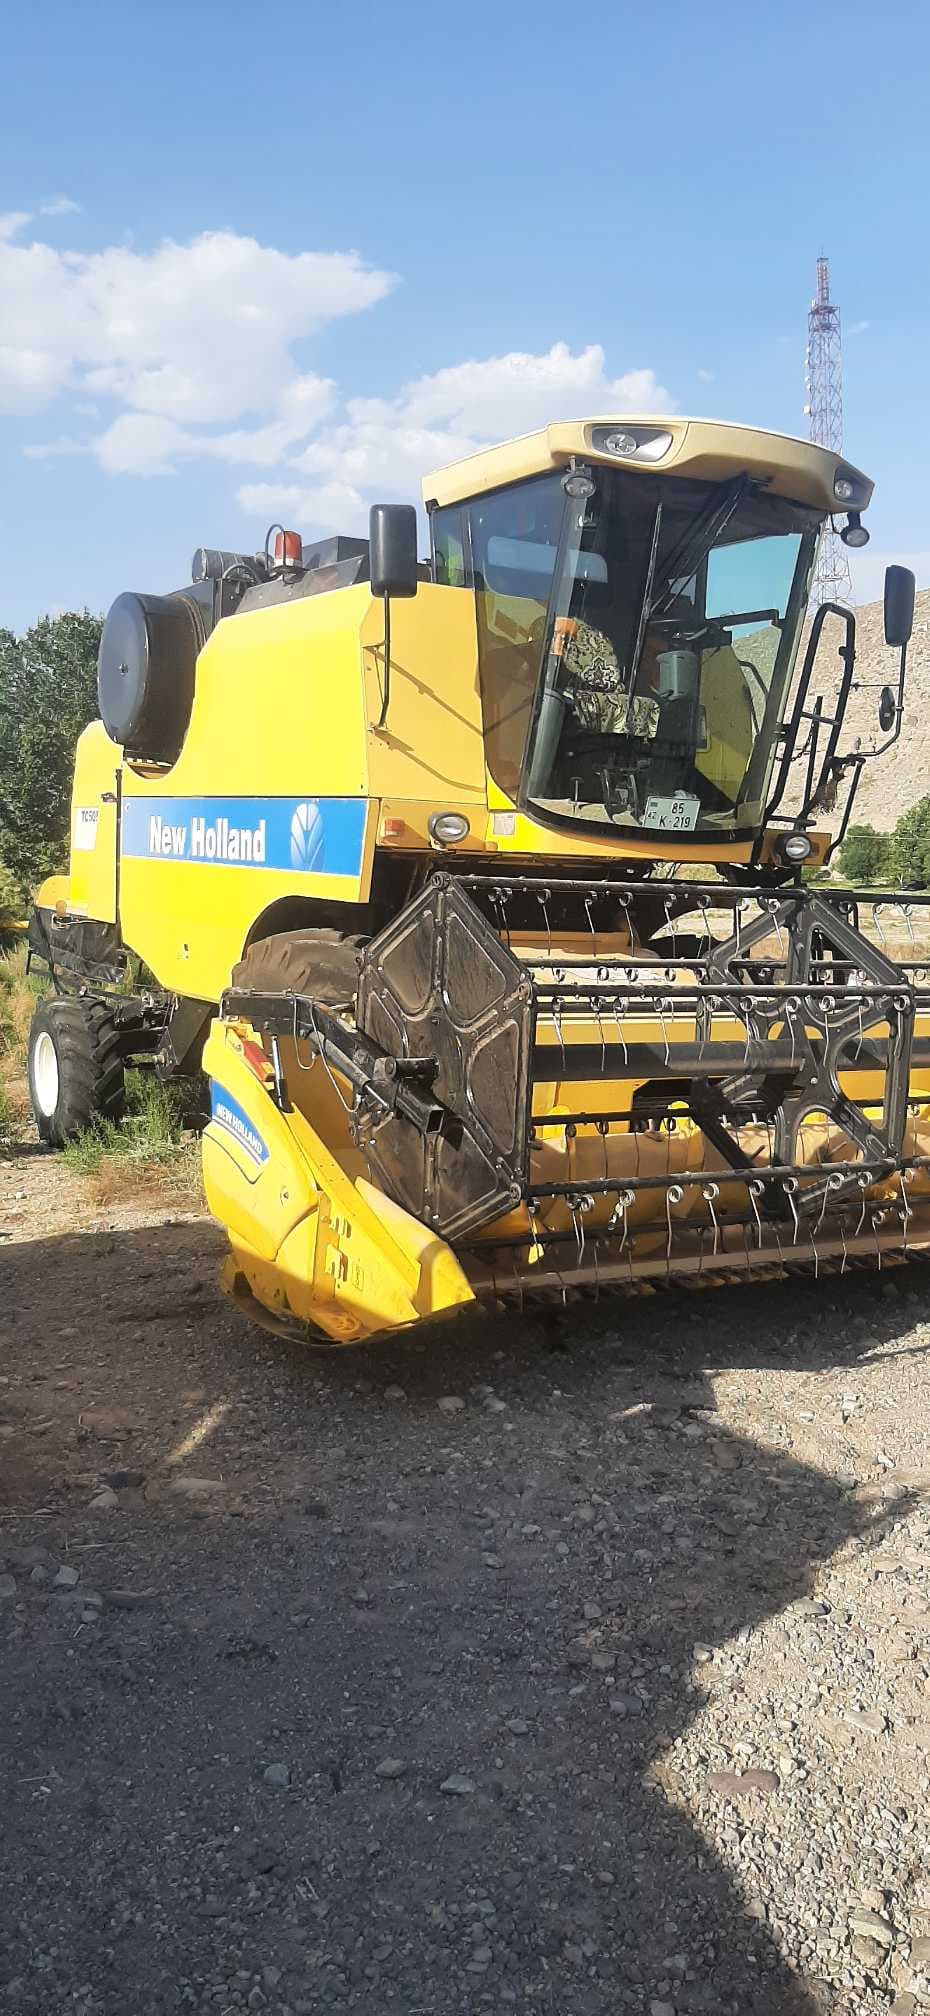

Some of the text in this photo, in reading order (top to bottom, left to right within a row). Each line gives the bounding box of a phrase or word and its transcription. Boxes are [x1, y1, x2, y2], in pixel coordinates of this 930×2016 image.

[671, 802, 684, 814] 85
[149, 815, 266, 862] New Holland
[215, 1102, 263, 1155] NEW HOLLAND
